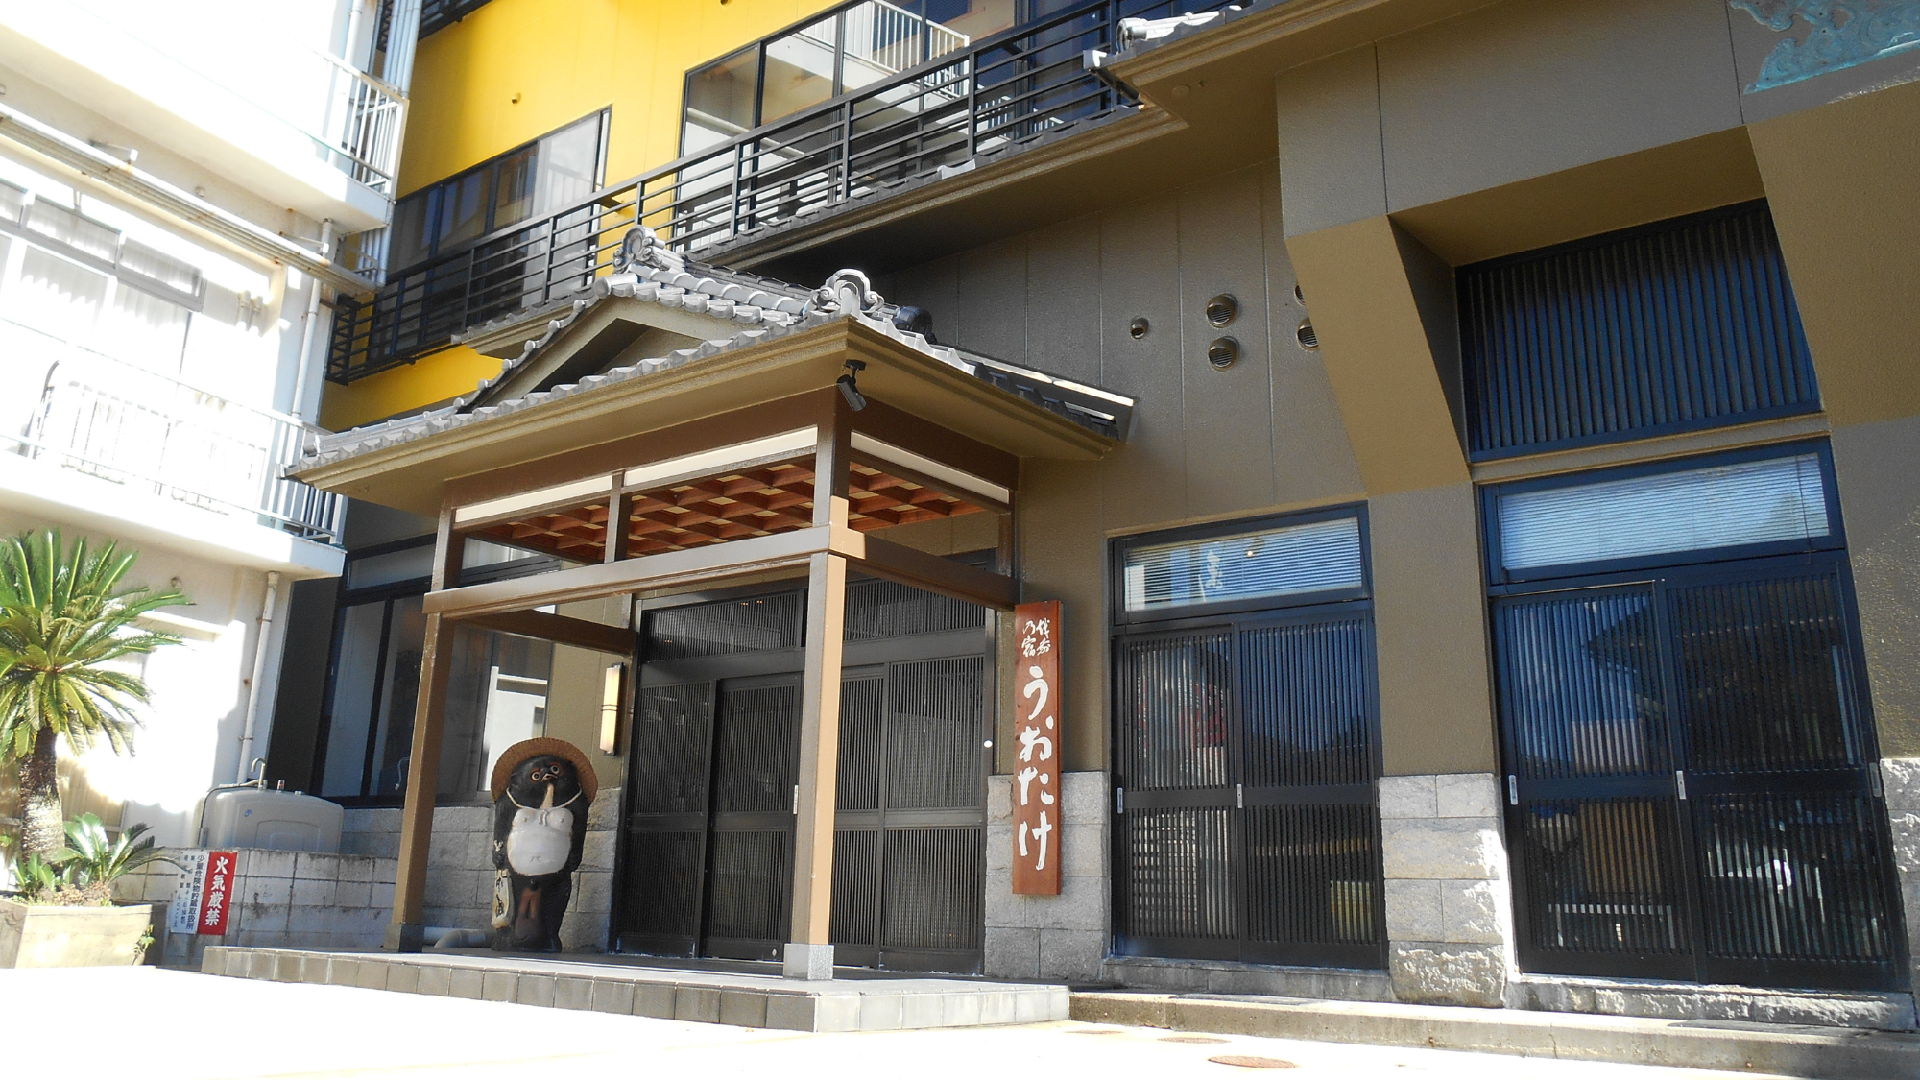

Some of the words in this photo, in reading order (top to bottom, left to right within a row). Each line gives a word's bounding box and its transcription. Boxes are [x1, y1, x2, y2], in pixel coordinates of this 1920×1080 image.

[1018, 665, 1055, 871] うおたけ
[204, 856, 229, 926] 火気厳禁
